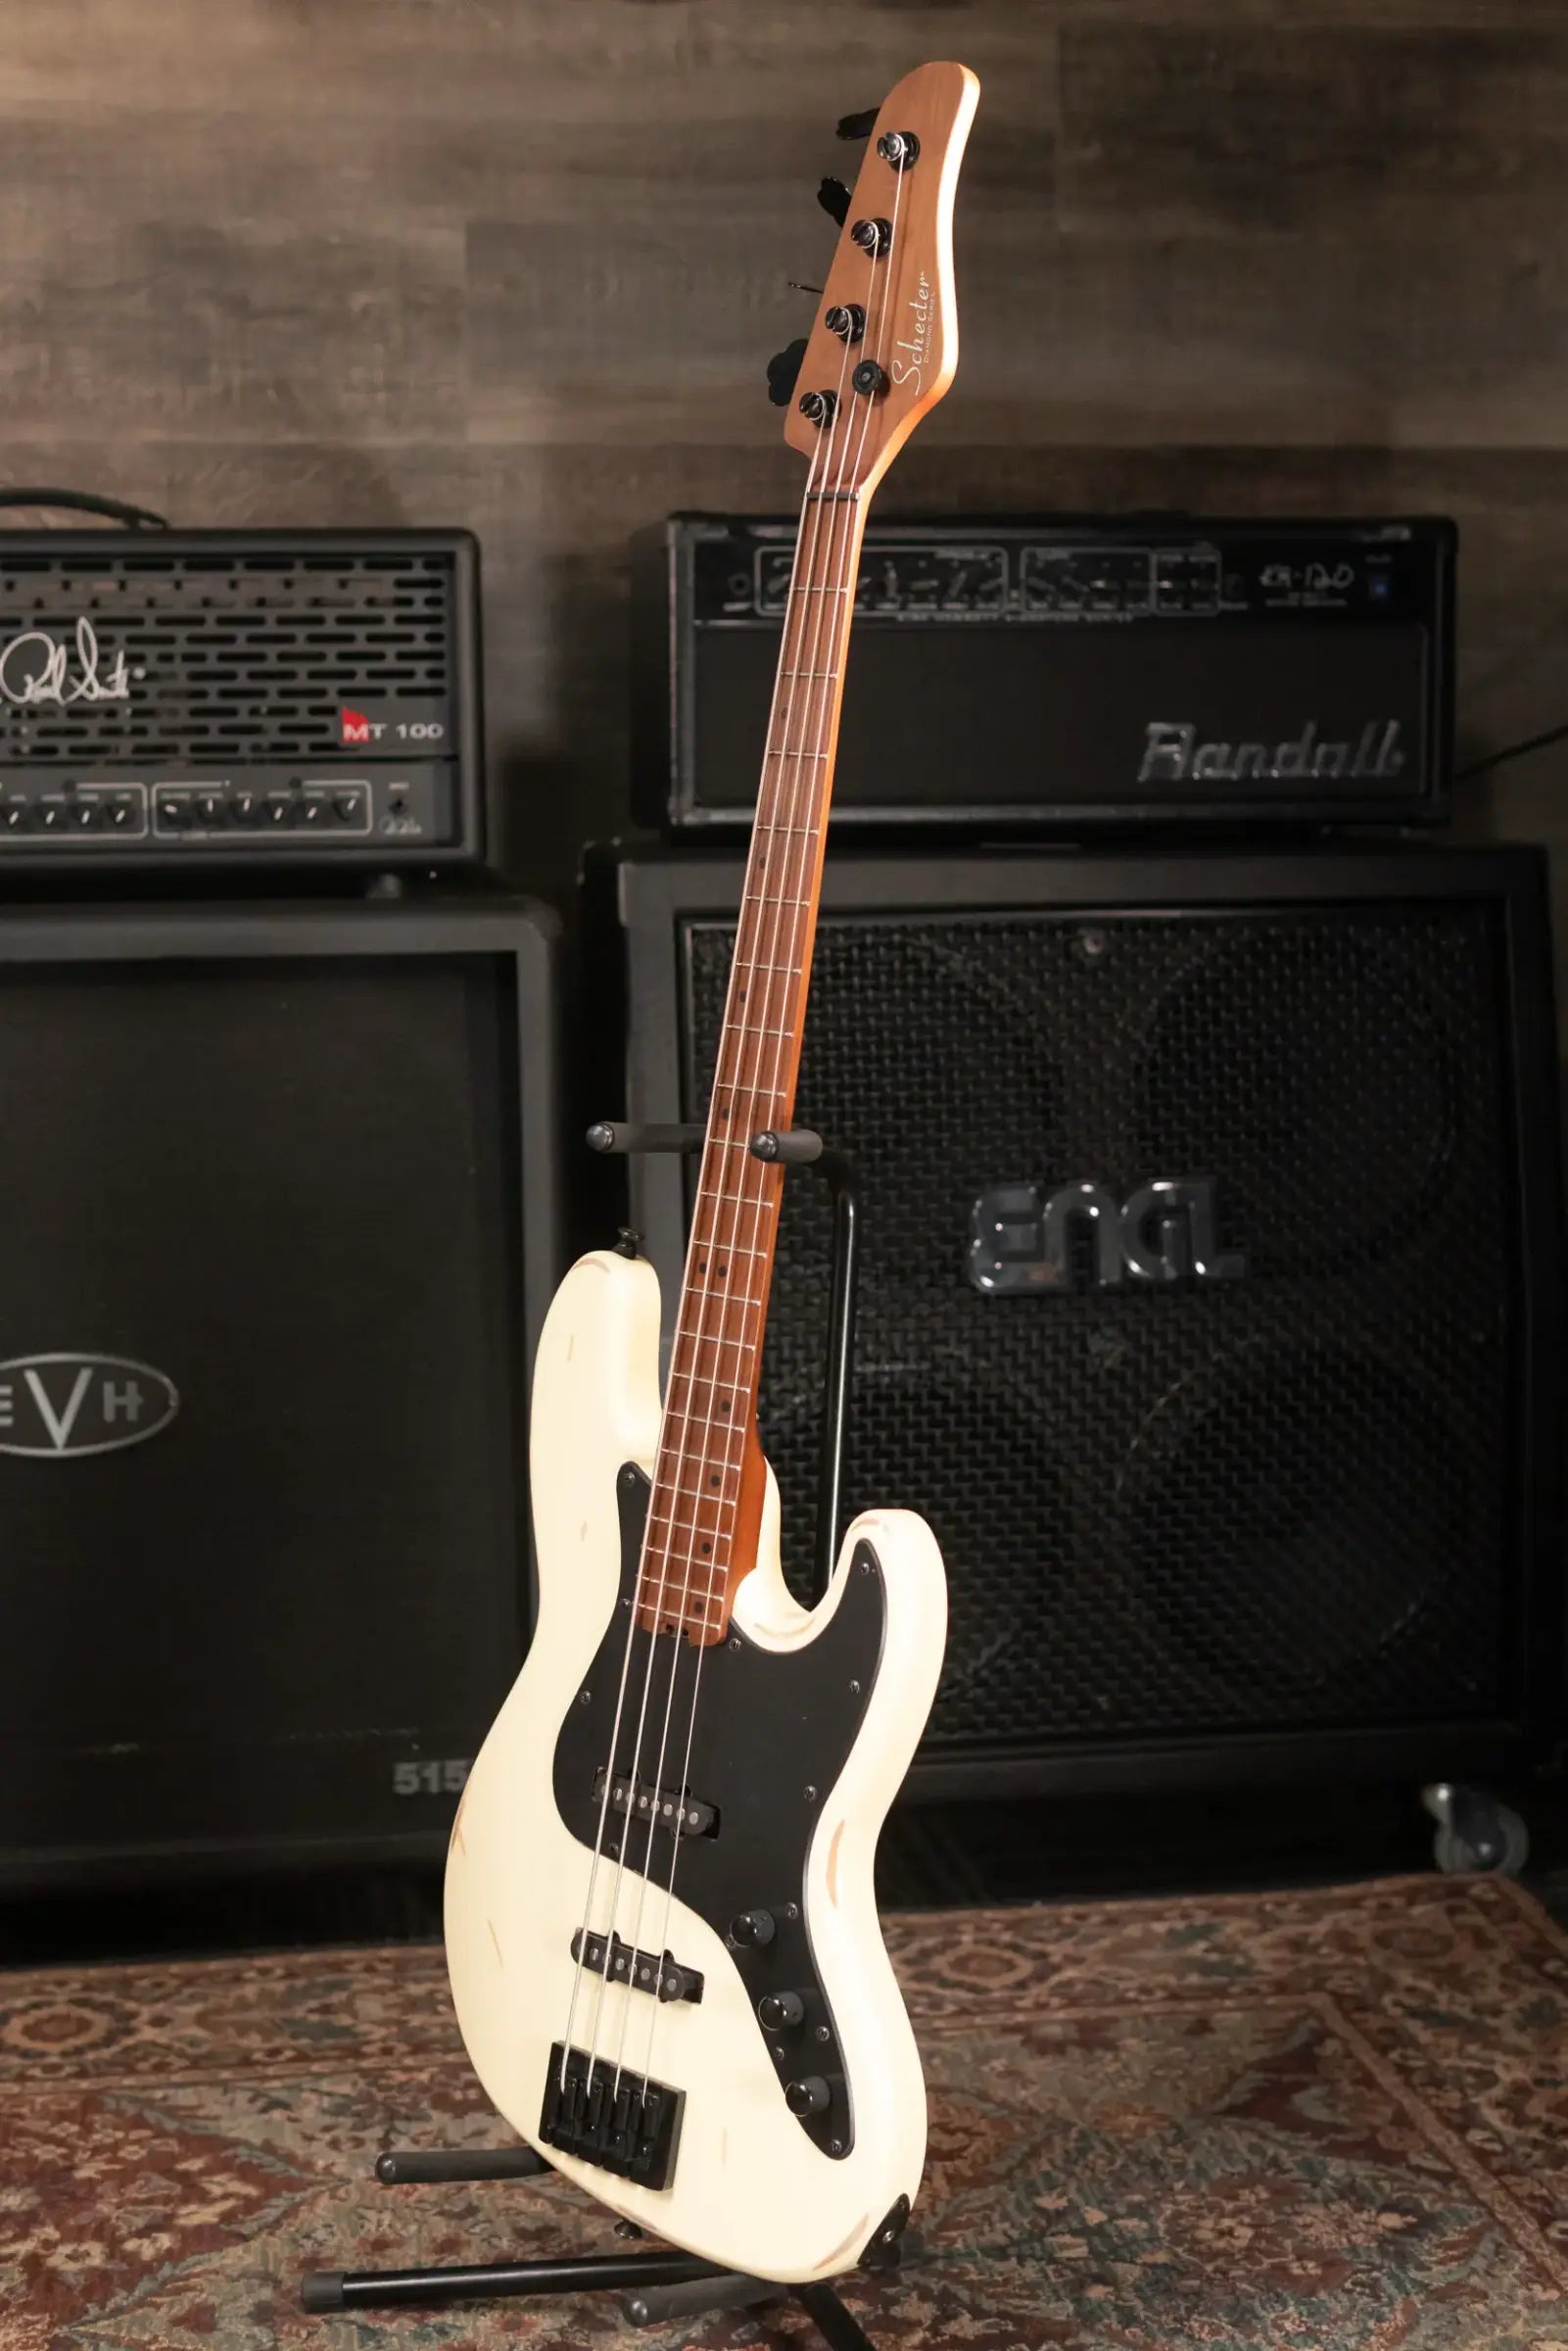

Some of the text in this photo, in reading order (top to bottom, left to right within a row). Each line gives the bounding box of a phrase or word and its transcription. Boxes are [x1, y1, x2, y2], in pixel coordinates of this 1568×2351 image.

[891, 270, 929, 396] Schecter
[343, 722, 445, 742] MT 100
[1136, 719, 1404, 783] Randall
